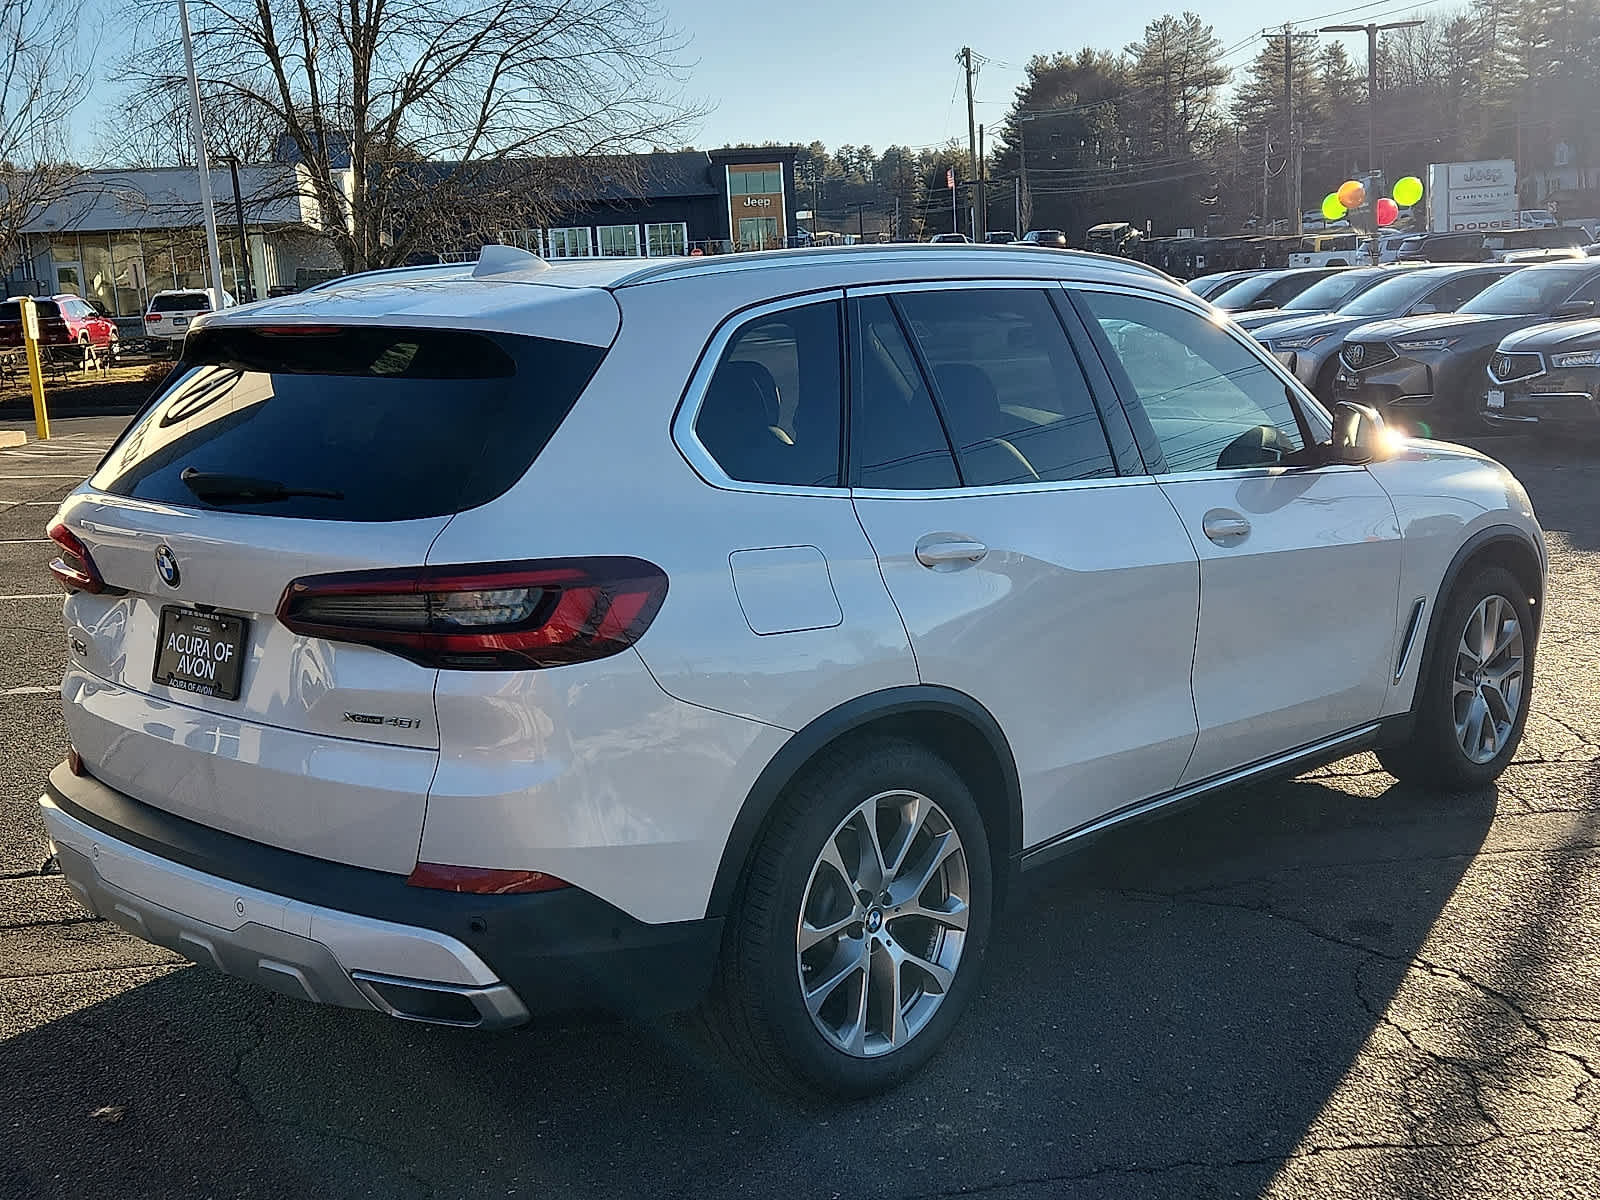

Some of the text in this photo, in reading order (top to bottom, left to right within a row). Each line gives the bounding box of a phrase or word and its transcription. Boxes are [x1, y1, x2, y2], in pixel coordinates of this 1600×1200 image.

[1463, 167, 1504, 182] Jeep
[743, 196, 771, 208] Jeep
[1454, 220, 1511, 231] DODGE
[166, 632, 233, 663] ACURA OF
[176, 654, 216, 680] AVON
[168, 678, 213, 696] ACURA OF AVON
